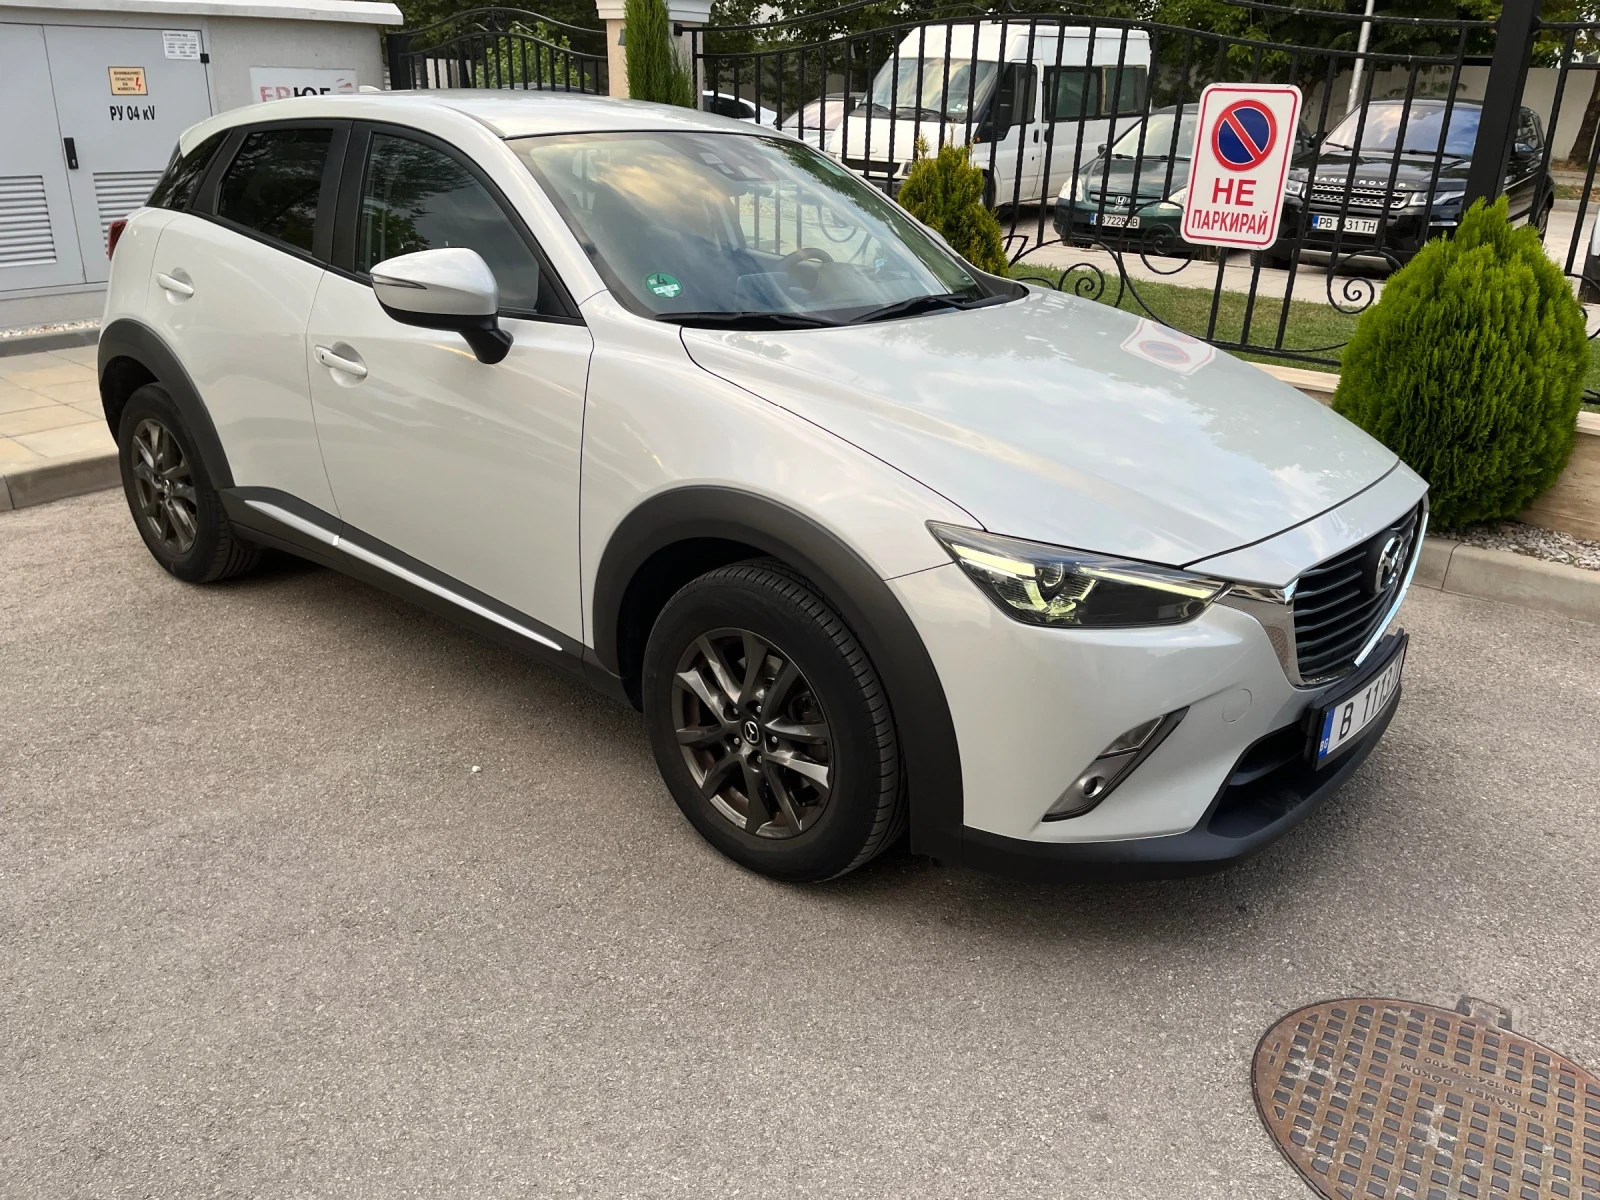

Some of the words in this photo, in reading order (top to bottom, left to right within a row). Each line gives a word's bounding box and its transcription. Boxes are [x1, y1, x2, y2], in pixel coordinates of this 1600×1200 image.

[109, 105, 123, 121] РУ
[127, 105, 140, 121] 04
[1211, 177, 1257, 206] НЕ
[1359, 180, 1407, 188] ROVR
[1191, 209, 1269, 235] ПАРКИРАЙ
[1339, 701, 1354, 741] B
[1319, 738, 1329, 752] BG
[1503, 1085, 1522, 1097] EN
